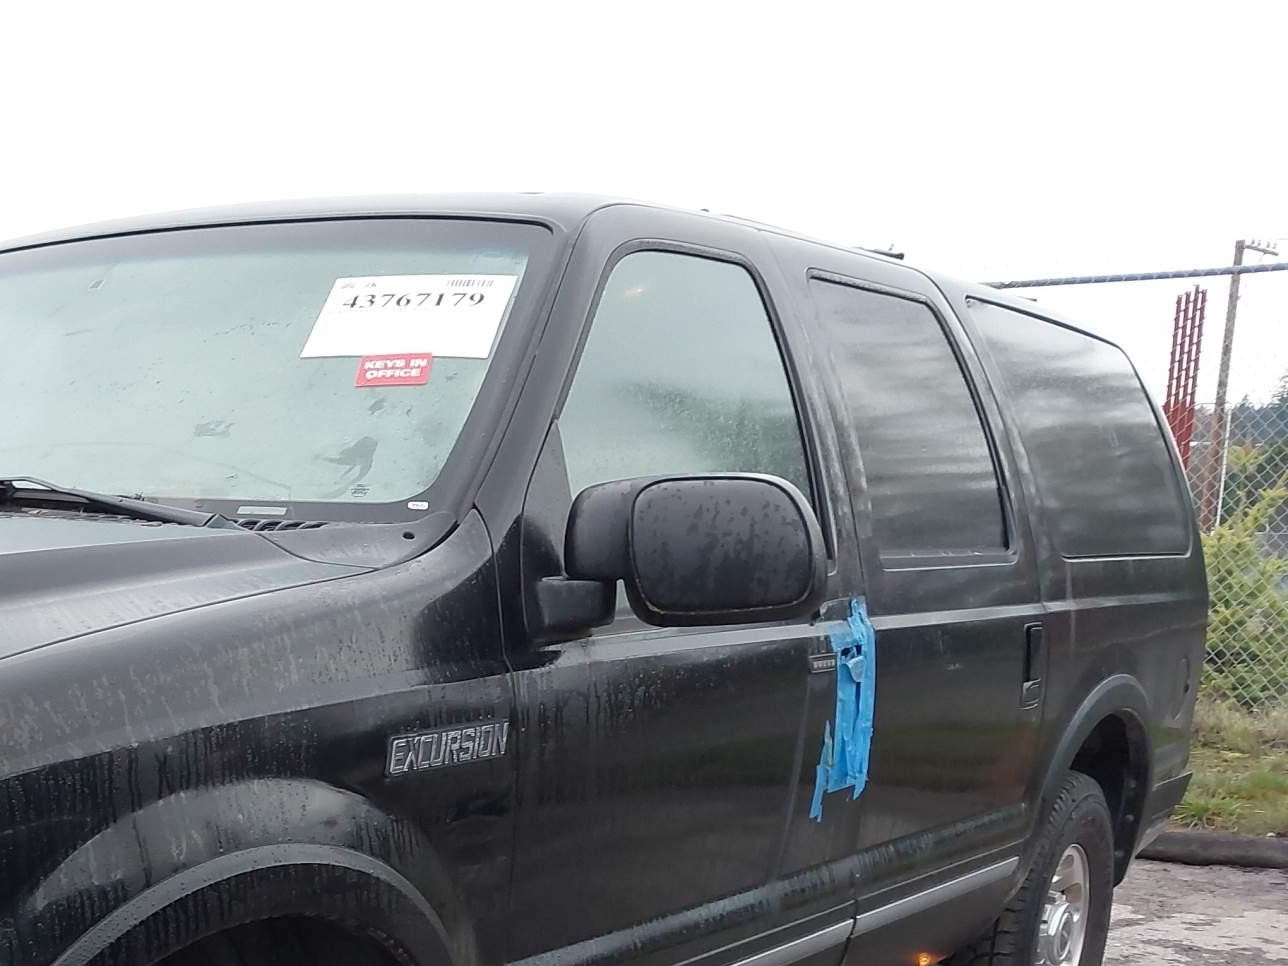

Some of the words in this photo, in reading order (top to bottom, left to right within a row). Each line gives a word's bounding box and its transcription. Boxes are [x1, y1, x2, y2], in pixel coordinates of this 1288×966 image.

[342, 293, 486, 308] 43767179
[364, 360, 406, 369] KEYS
[410, 359, 428, 367] IN
[365, 368, 421, 379] OFFICE
[390, 722, 509, 774] EXCURSION
